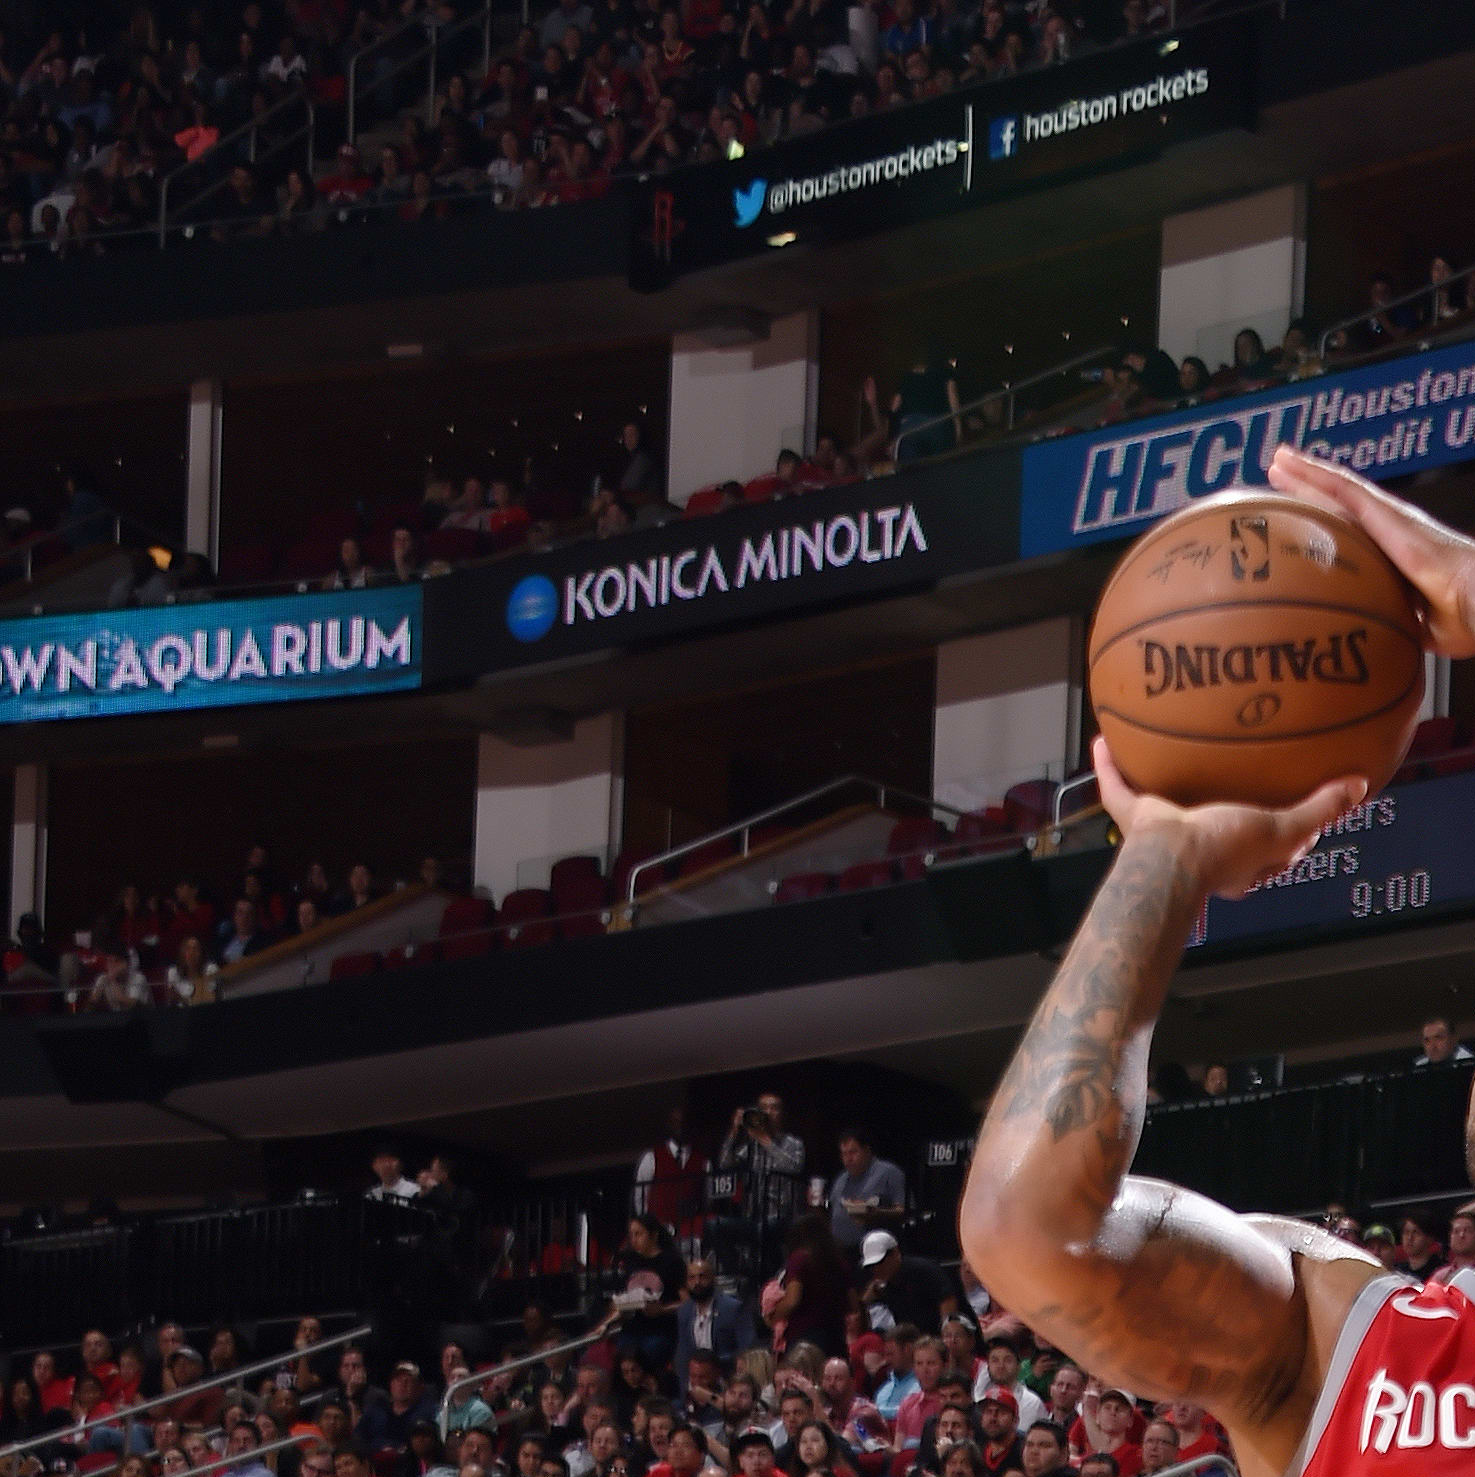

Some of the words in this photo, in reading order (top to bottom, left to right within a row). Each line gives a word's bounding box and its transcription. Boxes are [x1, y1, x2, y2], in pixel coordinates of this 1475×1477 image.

[1023, 92, 1116, 142] houston
[1122, 67, 1209, 115] rockets
[768, 137, 958, 214] @houstonrockets
[1073, 396, 1312, 534] HFCU
[562, 546, 730, 625] KONICA
[734, 502, 929, 589] MINOLTA
[0, 638, 98, 696] WN
[108, 615, 412, 694] AQUARIUM
[1143, 629, 1370, 699] SPALDING
[1244, 845, 1360, 894] azers
[1351, 871, 1431, 919] 9:00
[714, 1176, 733, 1194] 105
